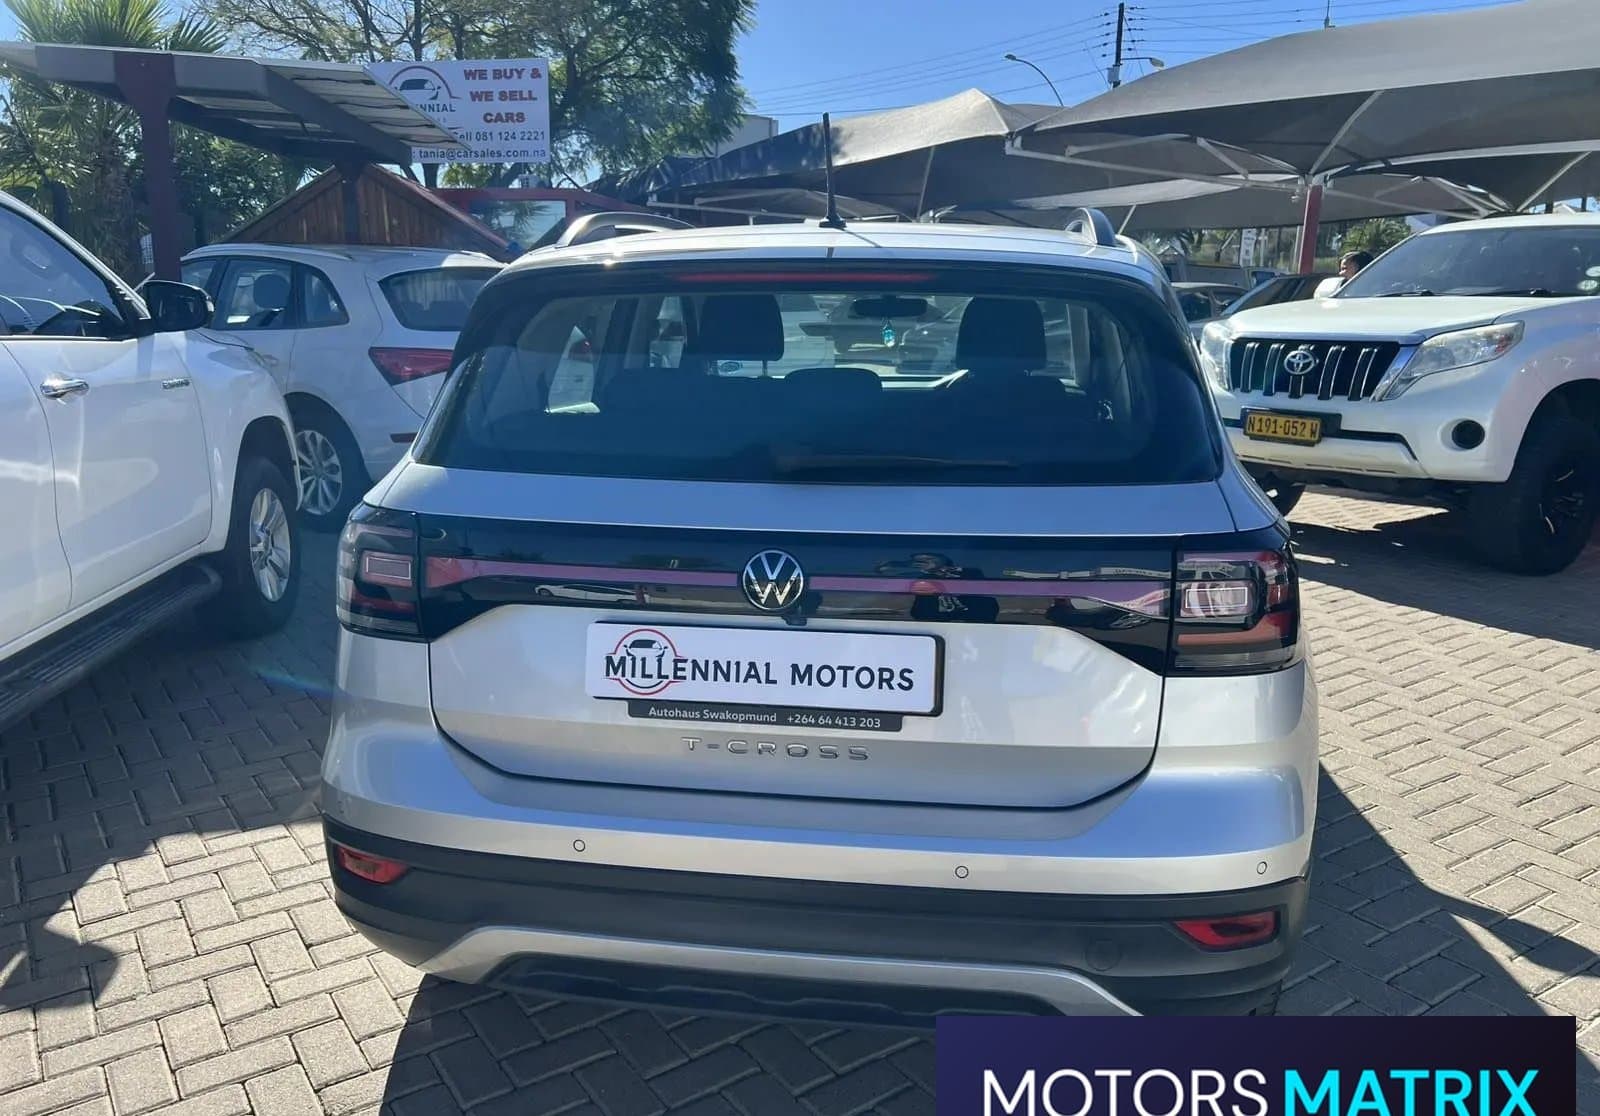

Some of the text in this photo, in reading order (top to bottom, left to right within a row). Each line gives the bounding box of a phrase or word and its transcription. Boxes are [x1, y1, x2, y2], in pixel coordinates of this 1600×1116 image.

[464, 68, 542, 80] WE BUY &
[470, 90, 538, 102] WE SELL
[483, 112, 526, 124] CARS
[498, 132, 517, 141] 124
[520, 130, 545, 141] 2221
[605, 655, 914, 691] MILLENNIAL MOTORS
[648, 706, 881, 728] Autohaus Swakopmund +264 64 413 203
[681, 737, 870, 761] T-CROSS
